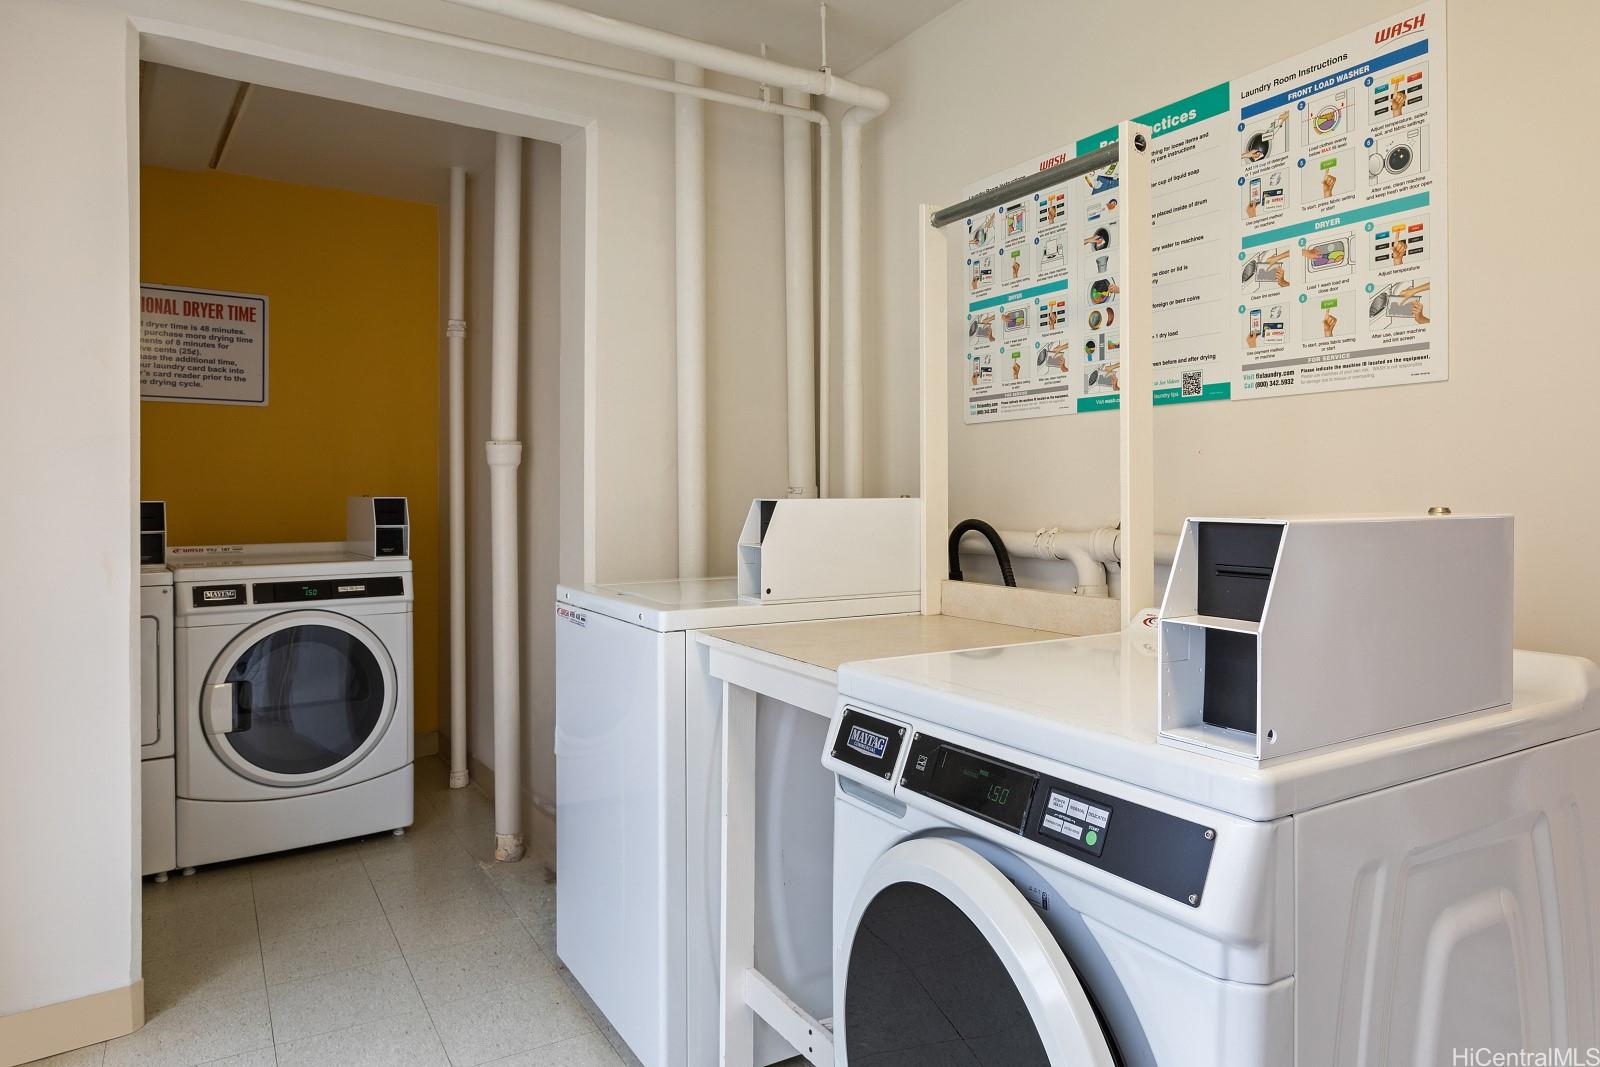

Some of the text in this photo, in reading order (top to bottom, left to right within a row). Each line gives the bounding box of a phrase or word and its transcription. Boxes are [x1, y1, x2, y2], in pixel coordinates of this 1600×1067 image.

[1374, 13, 1426, 44] WASH
[1240, 53, 1348, 99] Laundry Room Instructions
[1288, 65, 1370, 100] FRONT LOAD WASHER
[1407, 119, 1425, 128] settings
[1171, 141, 1184, 149] loose
[1185, 136, 1198, 144] items
[1200, 132, 1209, 140] and
[1157, 154, 1166, 162] care
[1167, 145, 1196, 158] instructions
[1040, 153, 1066, 171] WASH
[1271, 155, 1289, 165] detergent
[1158, 178, 1166, 187] cup
[1173, 172, 1187, 182] liquid
[1188, 168, 1200, 176] soap
[1341, 194, 1355, 202] setting
[1157, 208, 1172, 218] placed
[1173, 204, 1187, 212] inside
[1314, 218, 1341, 230] DRYER
[1161, 242, 1174, 250] water
[1181, 235, 1204, 244] machines
[1393, 265, 1421, 275] temperature
[183, 300, 223, 320] DRYER
[227, 304, 256, 323] TIME
[144, 329, 183, 337] purchase
[208, 334, 234, 343] drying
[212, 327, 246, 335] minutes.
[183, 341, 215, 349] minutes
[175, 356, 216, 364] additional
[218, 359, 238, 367] time,
[1322, 353, 1351, 361] SERVICE
[1403, 354, 1431, 363] equipment.
[153, 363, 185, 371] laundry
[202, 374, 222, 382] prior
[1256, 370, 1294, 379] fislaundry.com
[149, 379, 177, 387] drying
[1255, 381, 1268, 389] (800)
[1269, 378, 1294, 387] 342.5932
[851, 729, 886, 750] MAYTAG
